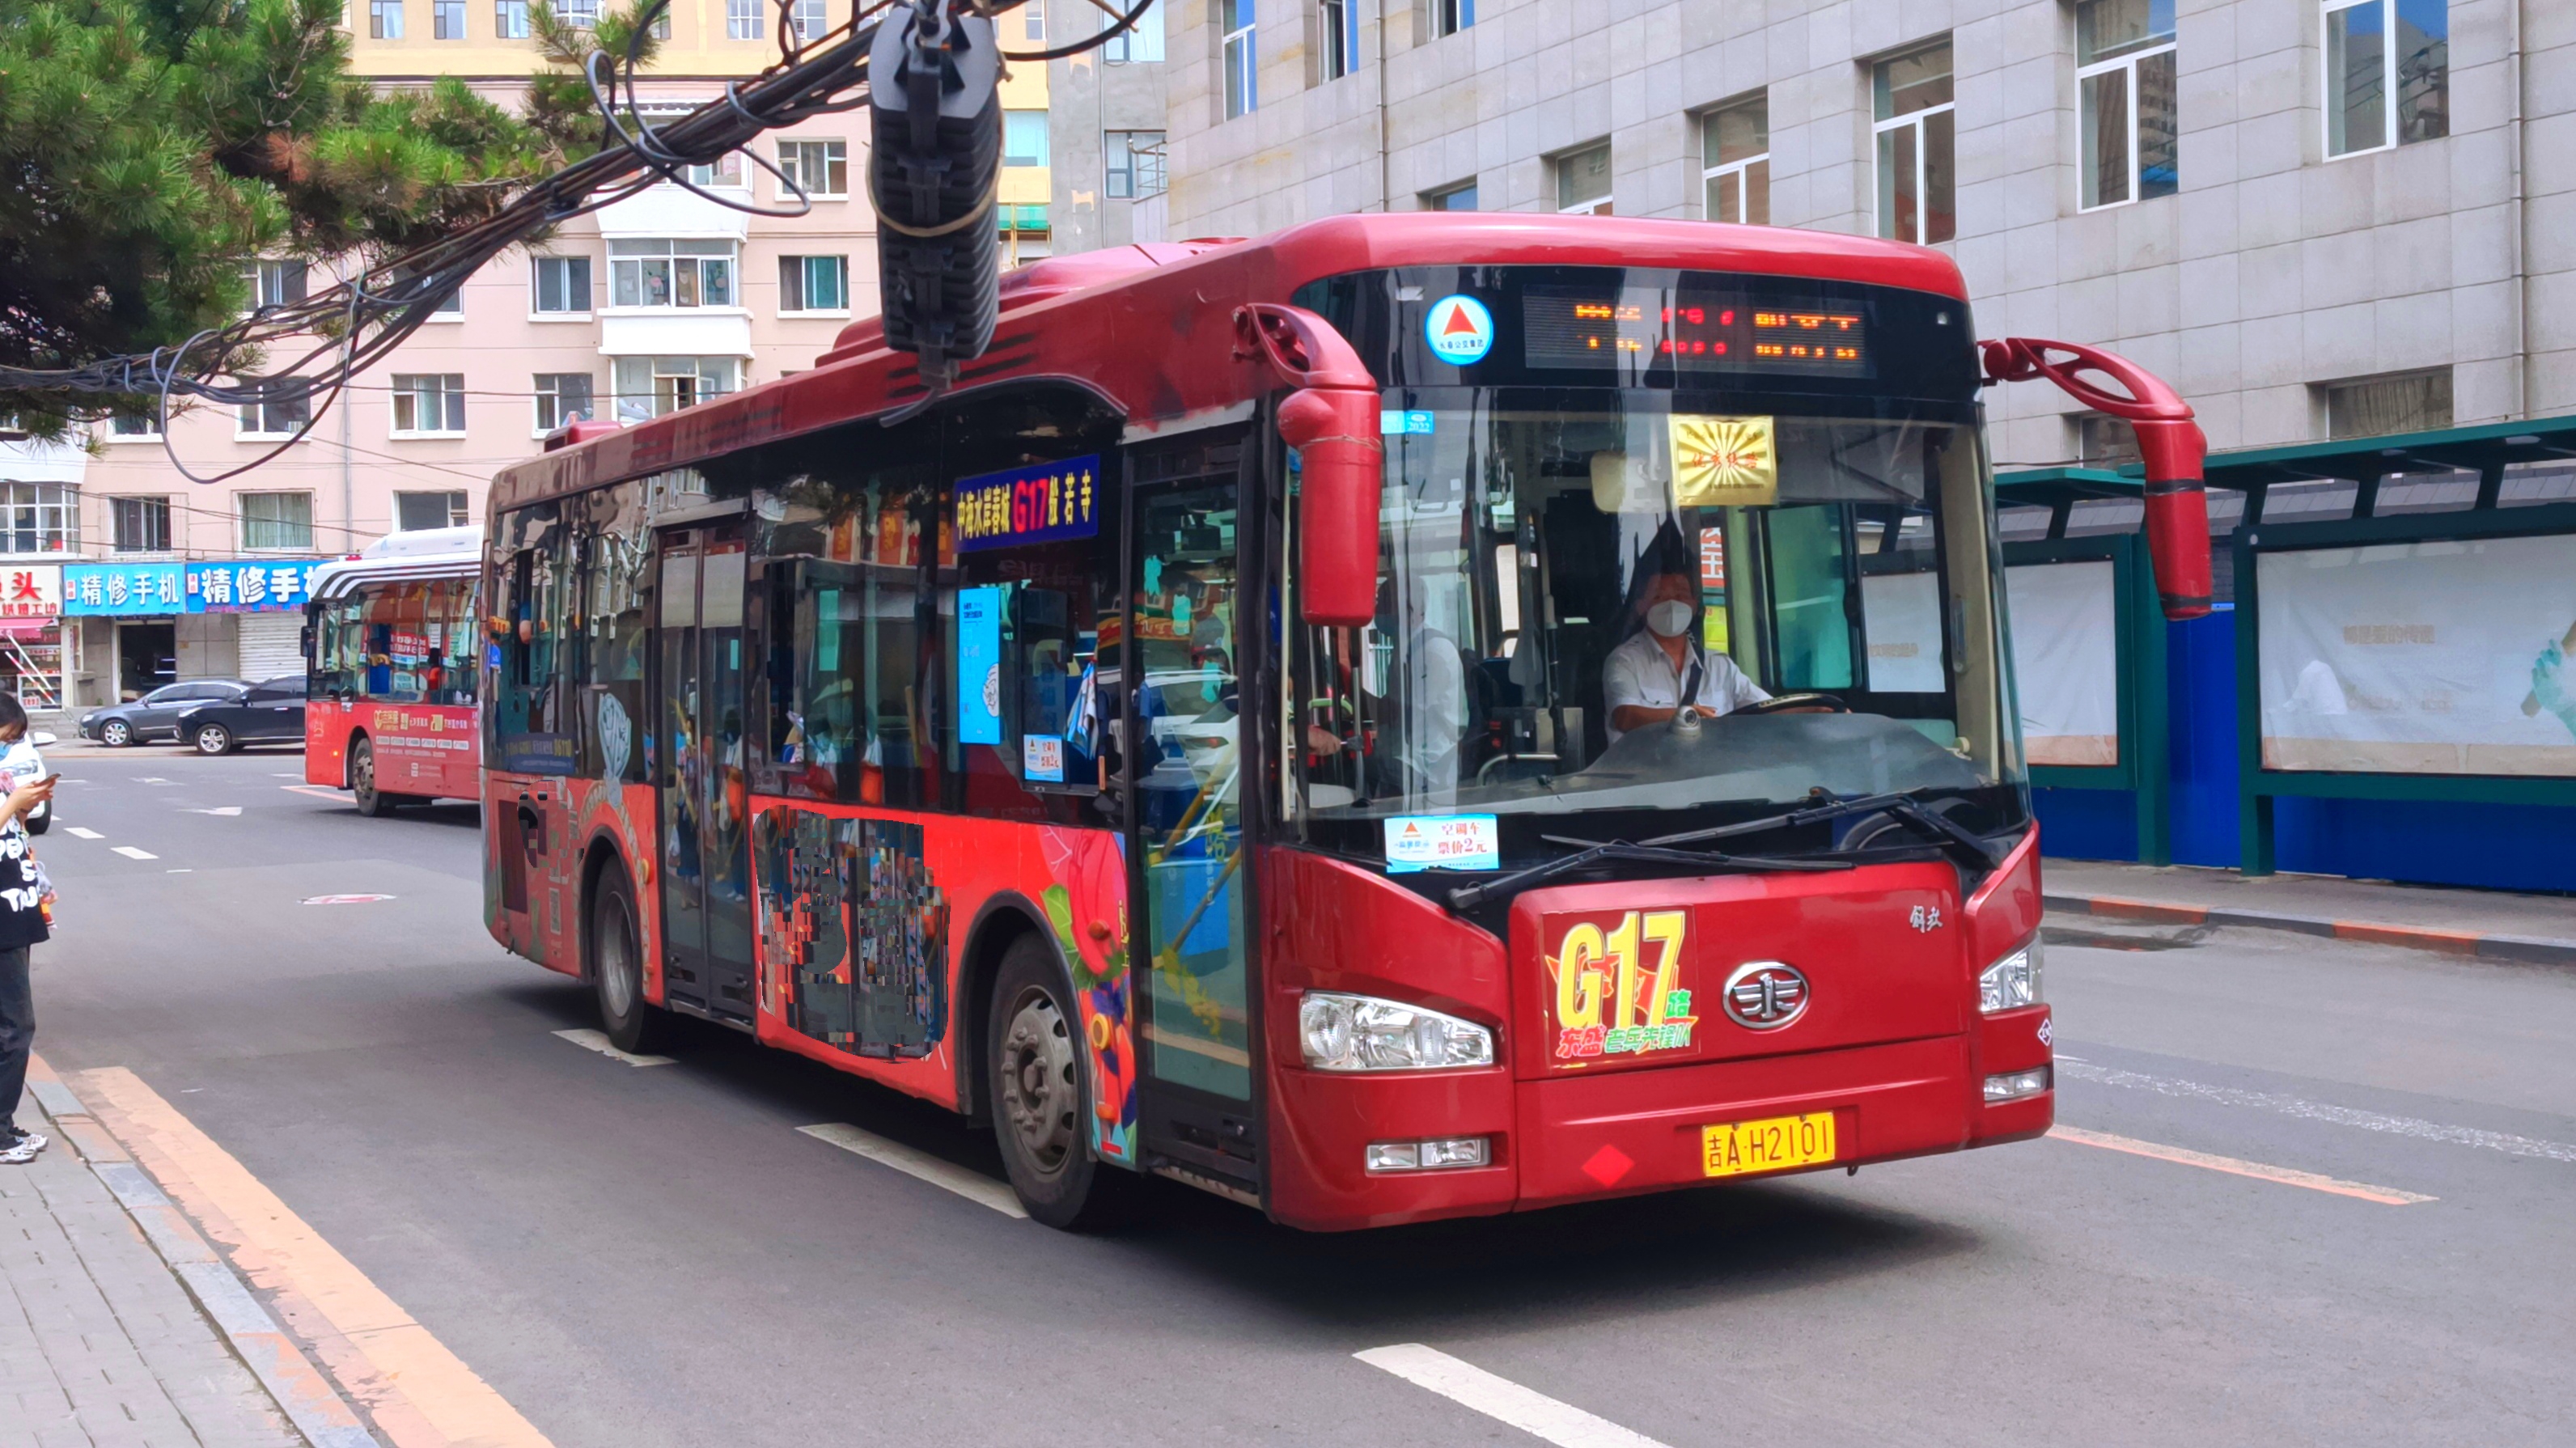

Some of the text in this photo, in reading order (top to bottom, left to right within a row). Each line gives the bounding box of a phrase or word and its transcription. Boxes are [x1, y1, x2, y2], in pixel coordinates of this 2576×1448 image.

[1014, 478, 1049, 533] G17
[0, 571, 42, 601] 头
[81, 573, 180, 606] 精修手机
[1438, 838, 1487, 854] 票价2元
[1557, 911, 1685, 1029] G17
